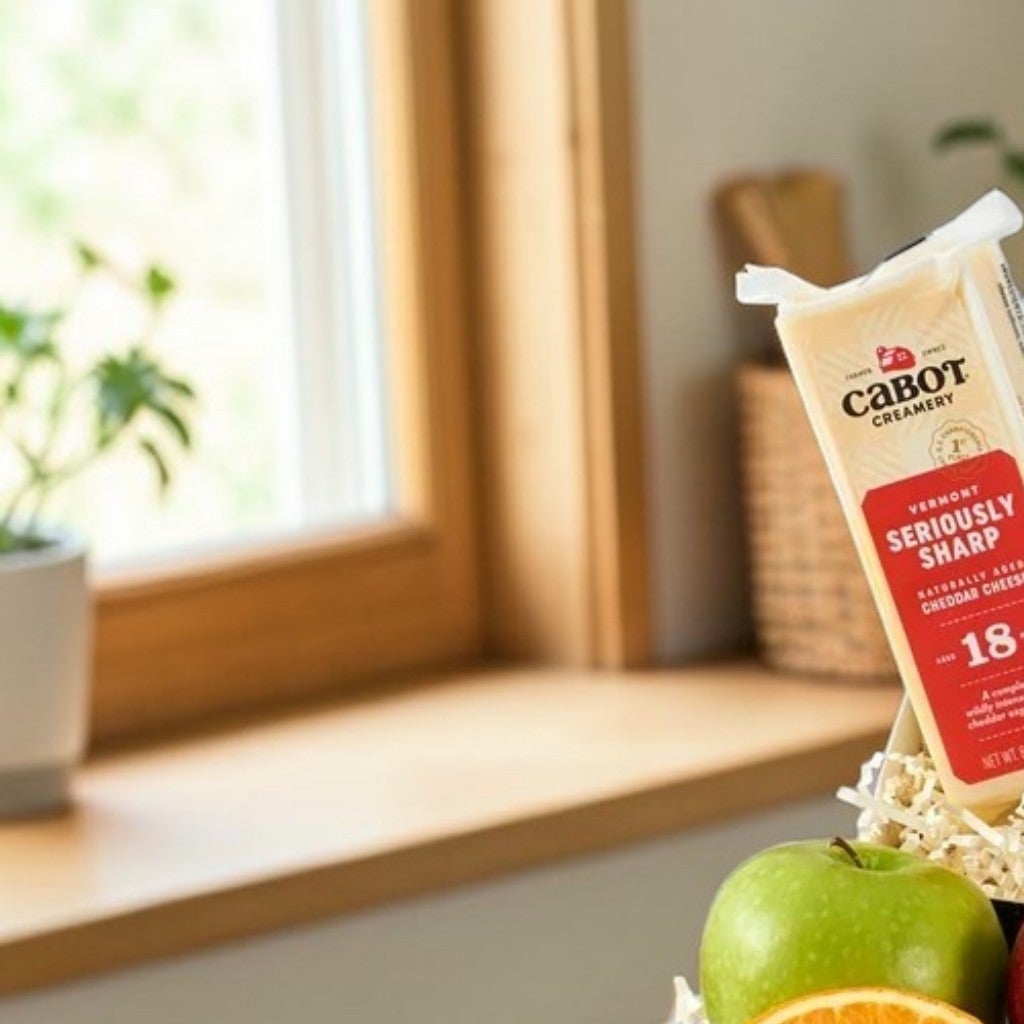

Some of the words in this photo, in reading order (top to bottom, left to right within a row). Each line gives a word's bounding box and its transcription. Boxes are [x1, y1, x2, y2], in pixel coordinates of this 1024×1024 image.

[872, 392, 954, 427] CREAMERY
[908, 485, 979, 515] VERMONT
[886, 492, 1015, 552] SERIOUSLY
[918, 526, 1000, 570] SHARP
[917, 571, 987, 599] NATURALLY
[992, 559, 1024, 576] AGED
[920, 587, 980, 615] CHEDDAR
[961, 622, 1017, 668] 18
[968, 712, 1006, 730] cheddar
[982, 752, 1001, 769] NET
